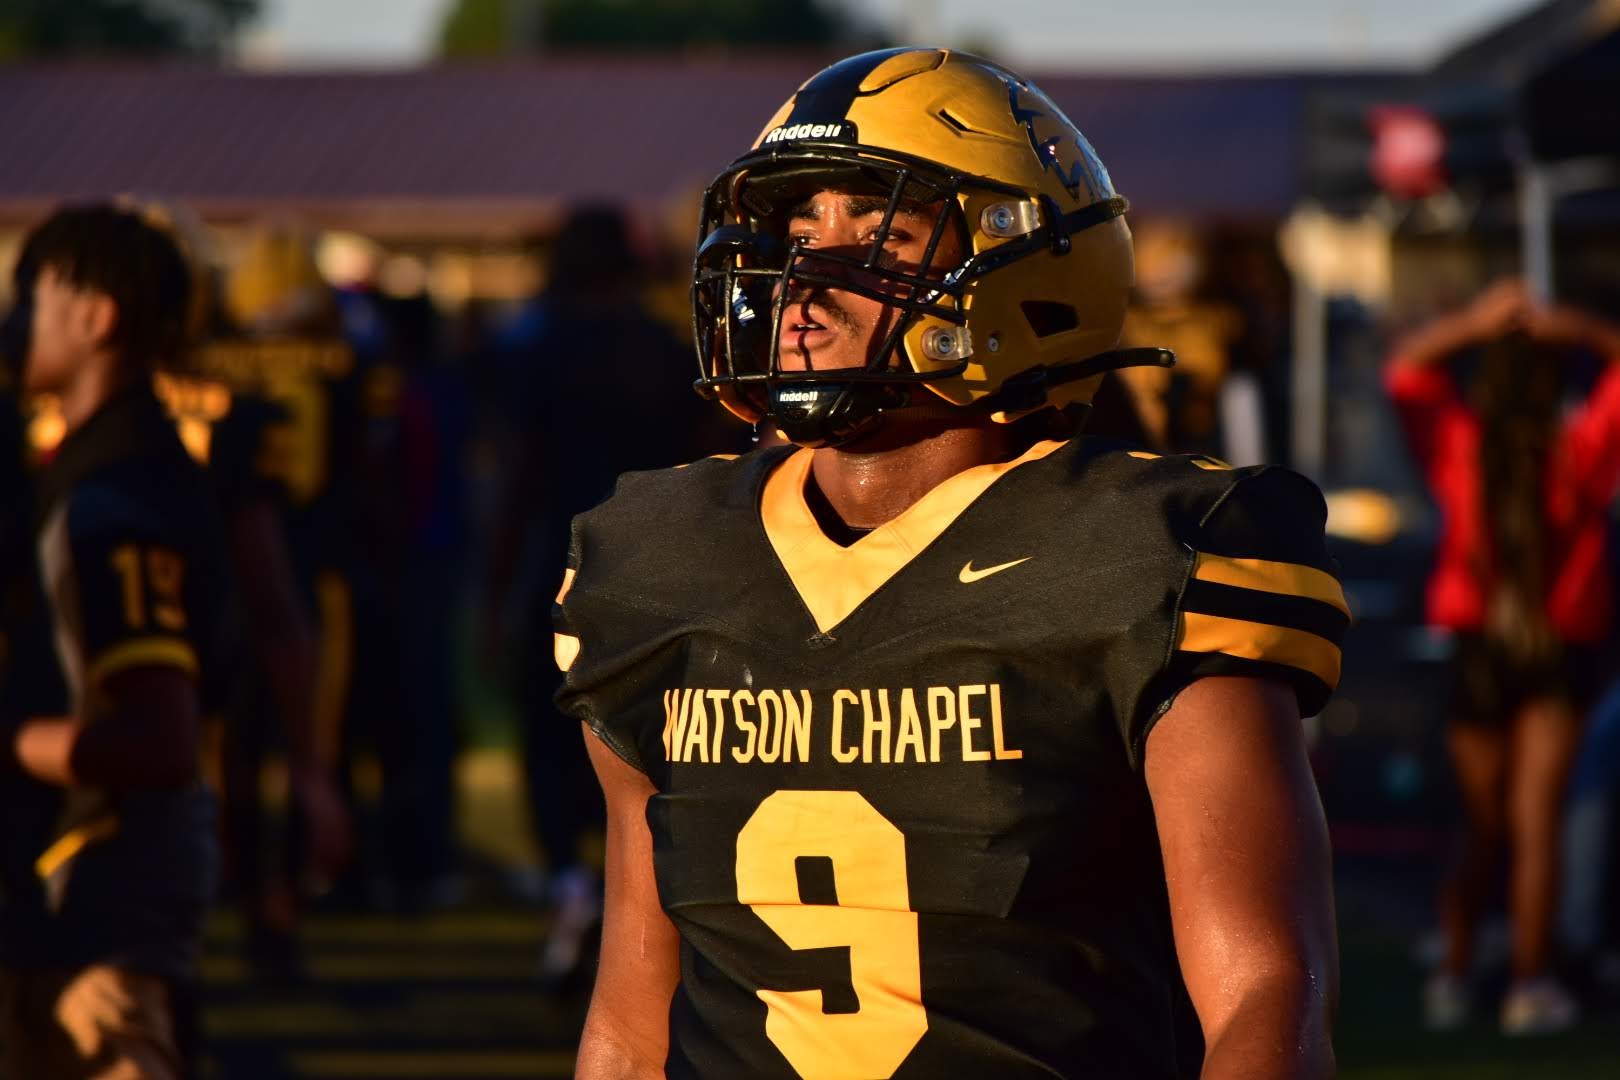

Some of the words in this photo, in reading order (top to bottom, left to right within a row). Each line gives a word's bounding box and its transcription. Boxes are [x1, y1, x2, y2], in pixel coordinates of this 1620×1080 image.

[765, 123, 842, 144] Riddell
[779, 390, 818, 402] Riddell
[662, 688, 813, 764] WATSON
[831, 683, 1023, 764] CHAPEL
[735, 789, 929, 1080] 9
